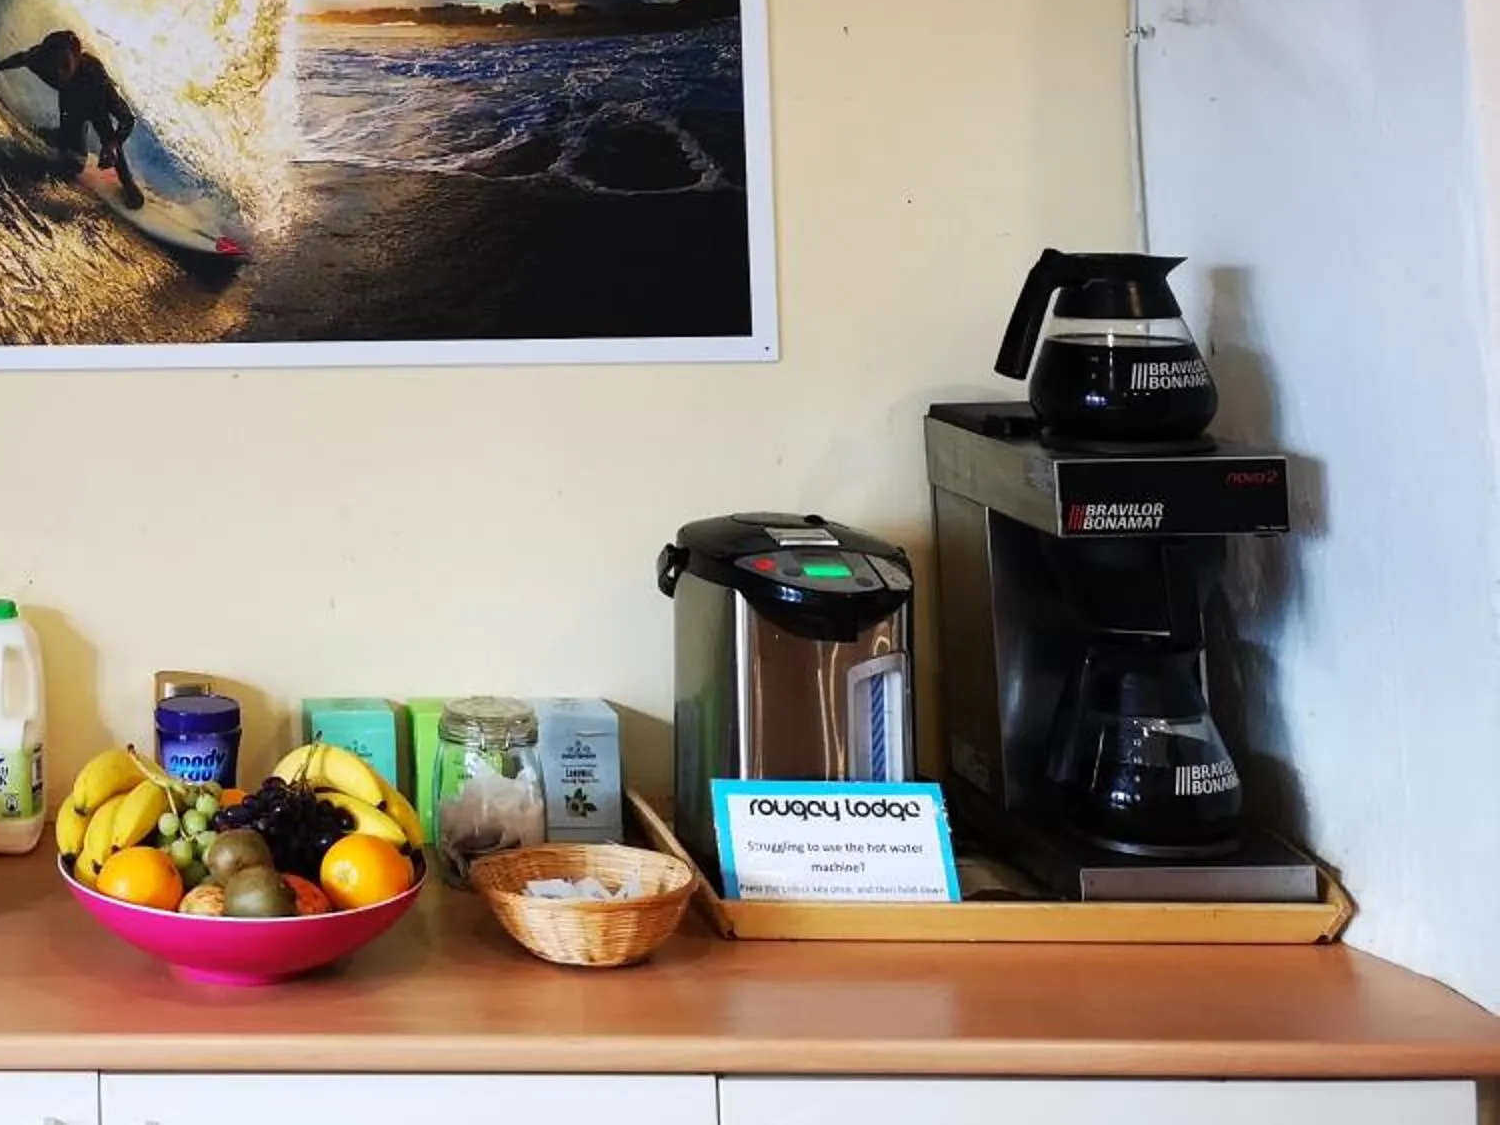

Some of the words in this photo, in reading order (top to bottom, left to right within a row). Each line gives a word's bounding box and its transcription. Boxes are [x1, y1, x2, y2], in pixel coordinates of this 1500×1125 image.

[1085, 502, 1165, 517] BRAVILOR
[1082, 515, 1163, 531] BONAMAT
[807, 842, 820, 853] to
[823, 844, 843, 853] use
[845, 842, 865, 853] the
[866, 842, 888, 853] hot
[889, 843, 924, 854] water
